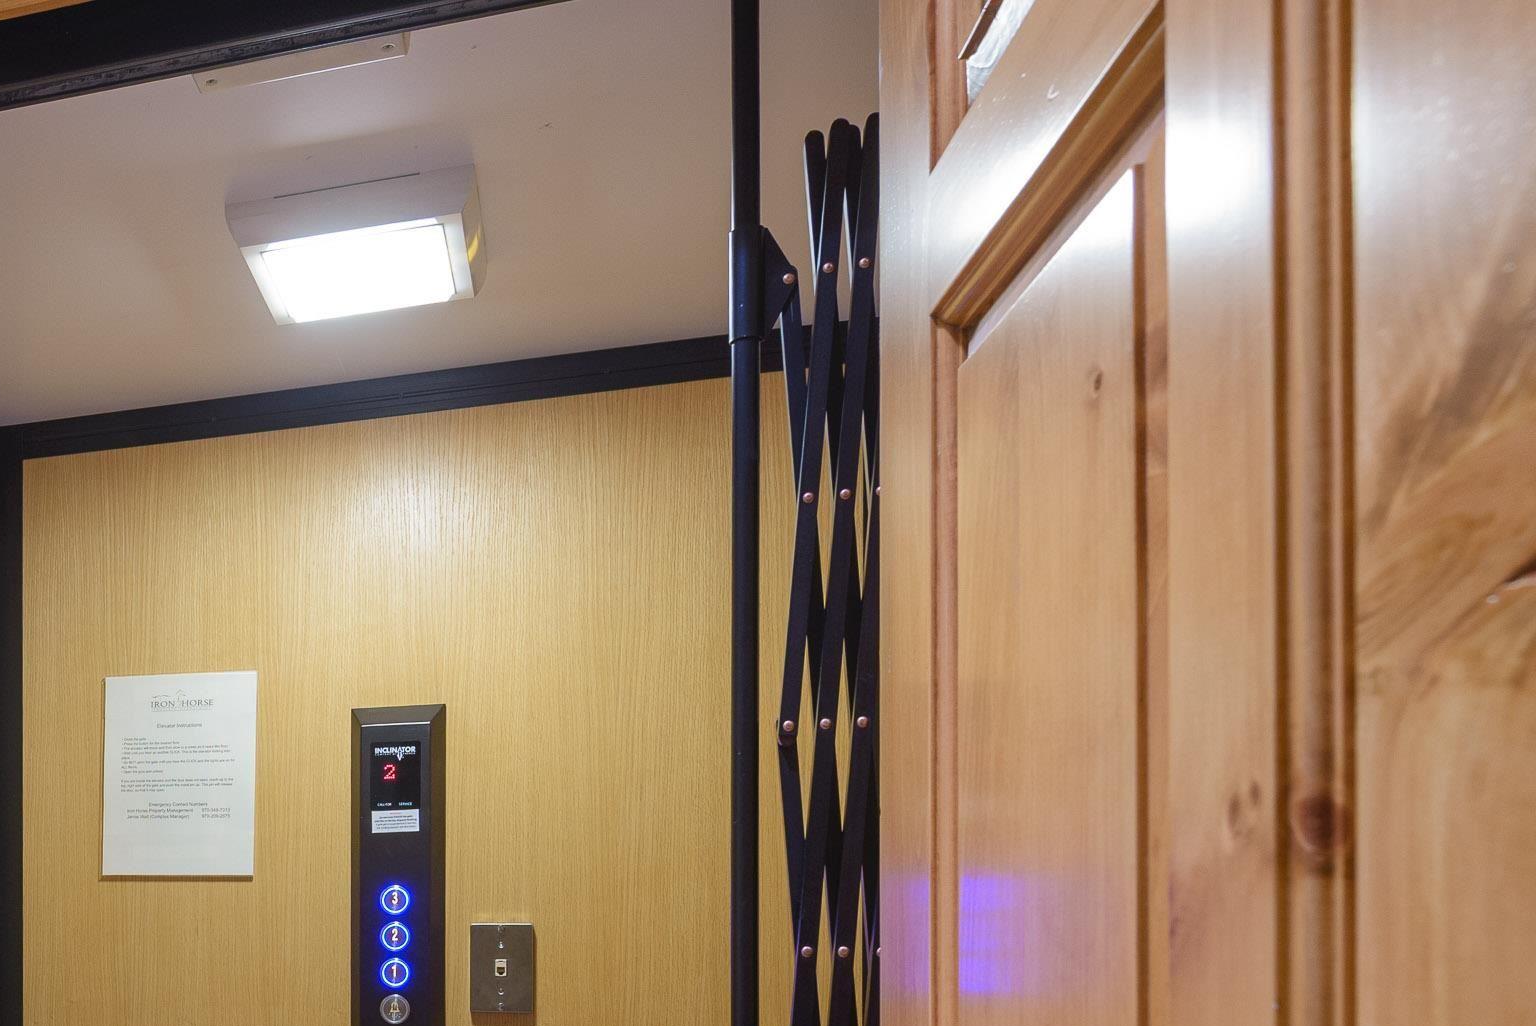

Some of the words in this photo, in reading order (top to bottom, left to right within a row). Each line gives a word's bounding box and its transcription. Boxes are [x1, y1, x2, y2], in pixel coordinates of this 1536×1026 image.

[151, 700, 175, 708] IRON
[182, 699, 214, 707] HORSE
[375, 746, 416, 754] INCLINATOR
[383, 764, 396, 780] 2
[391, 891, 399, 905] 3
[391, 928, 399, 941] 2
[391, 964, 397, 978] 1
